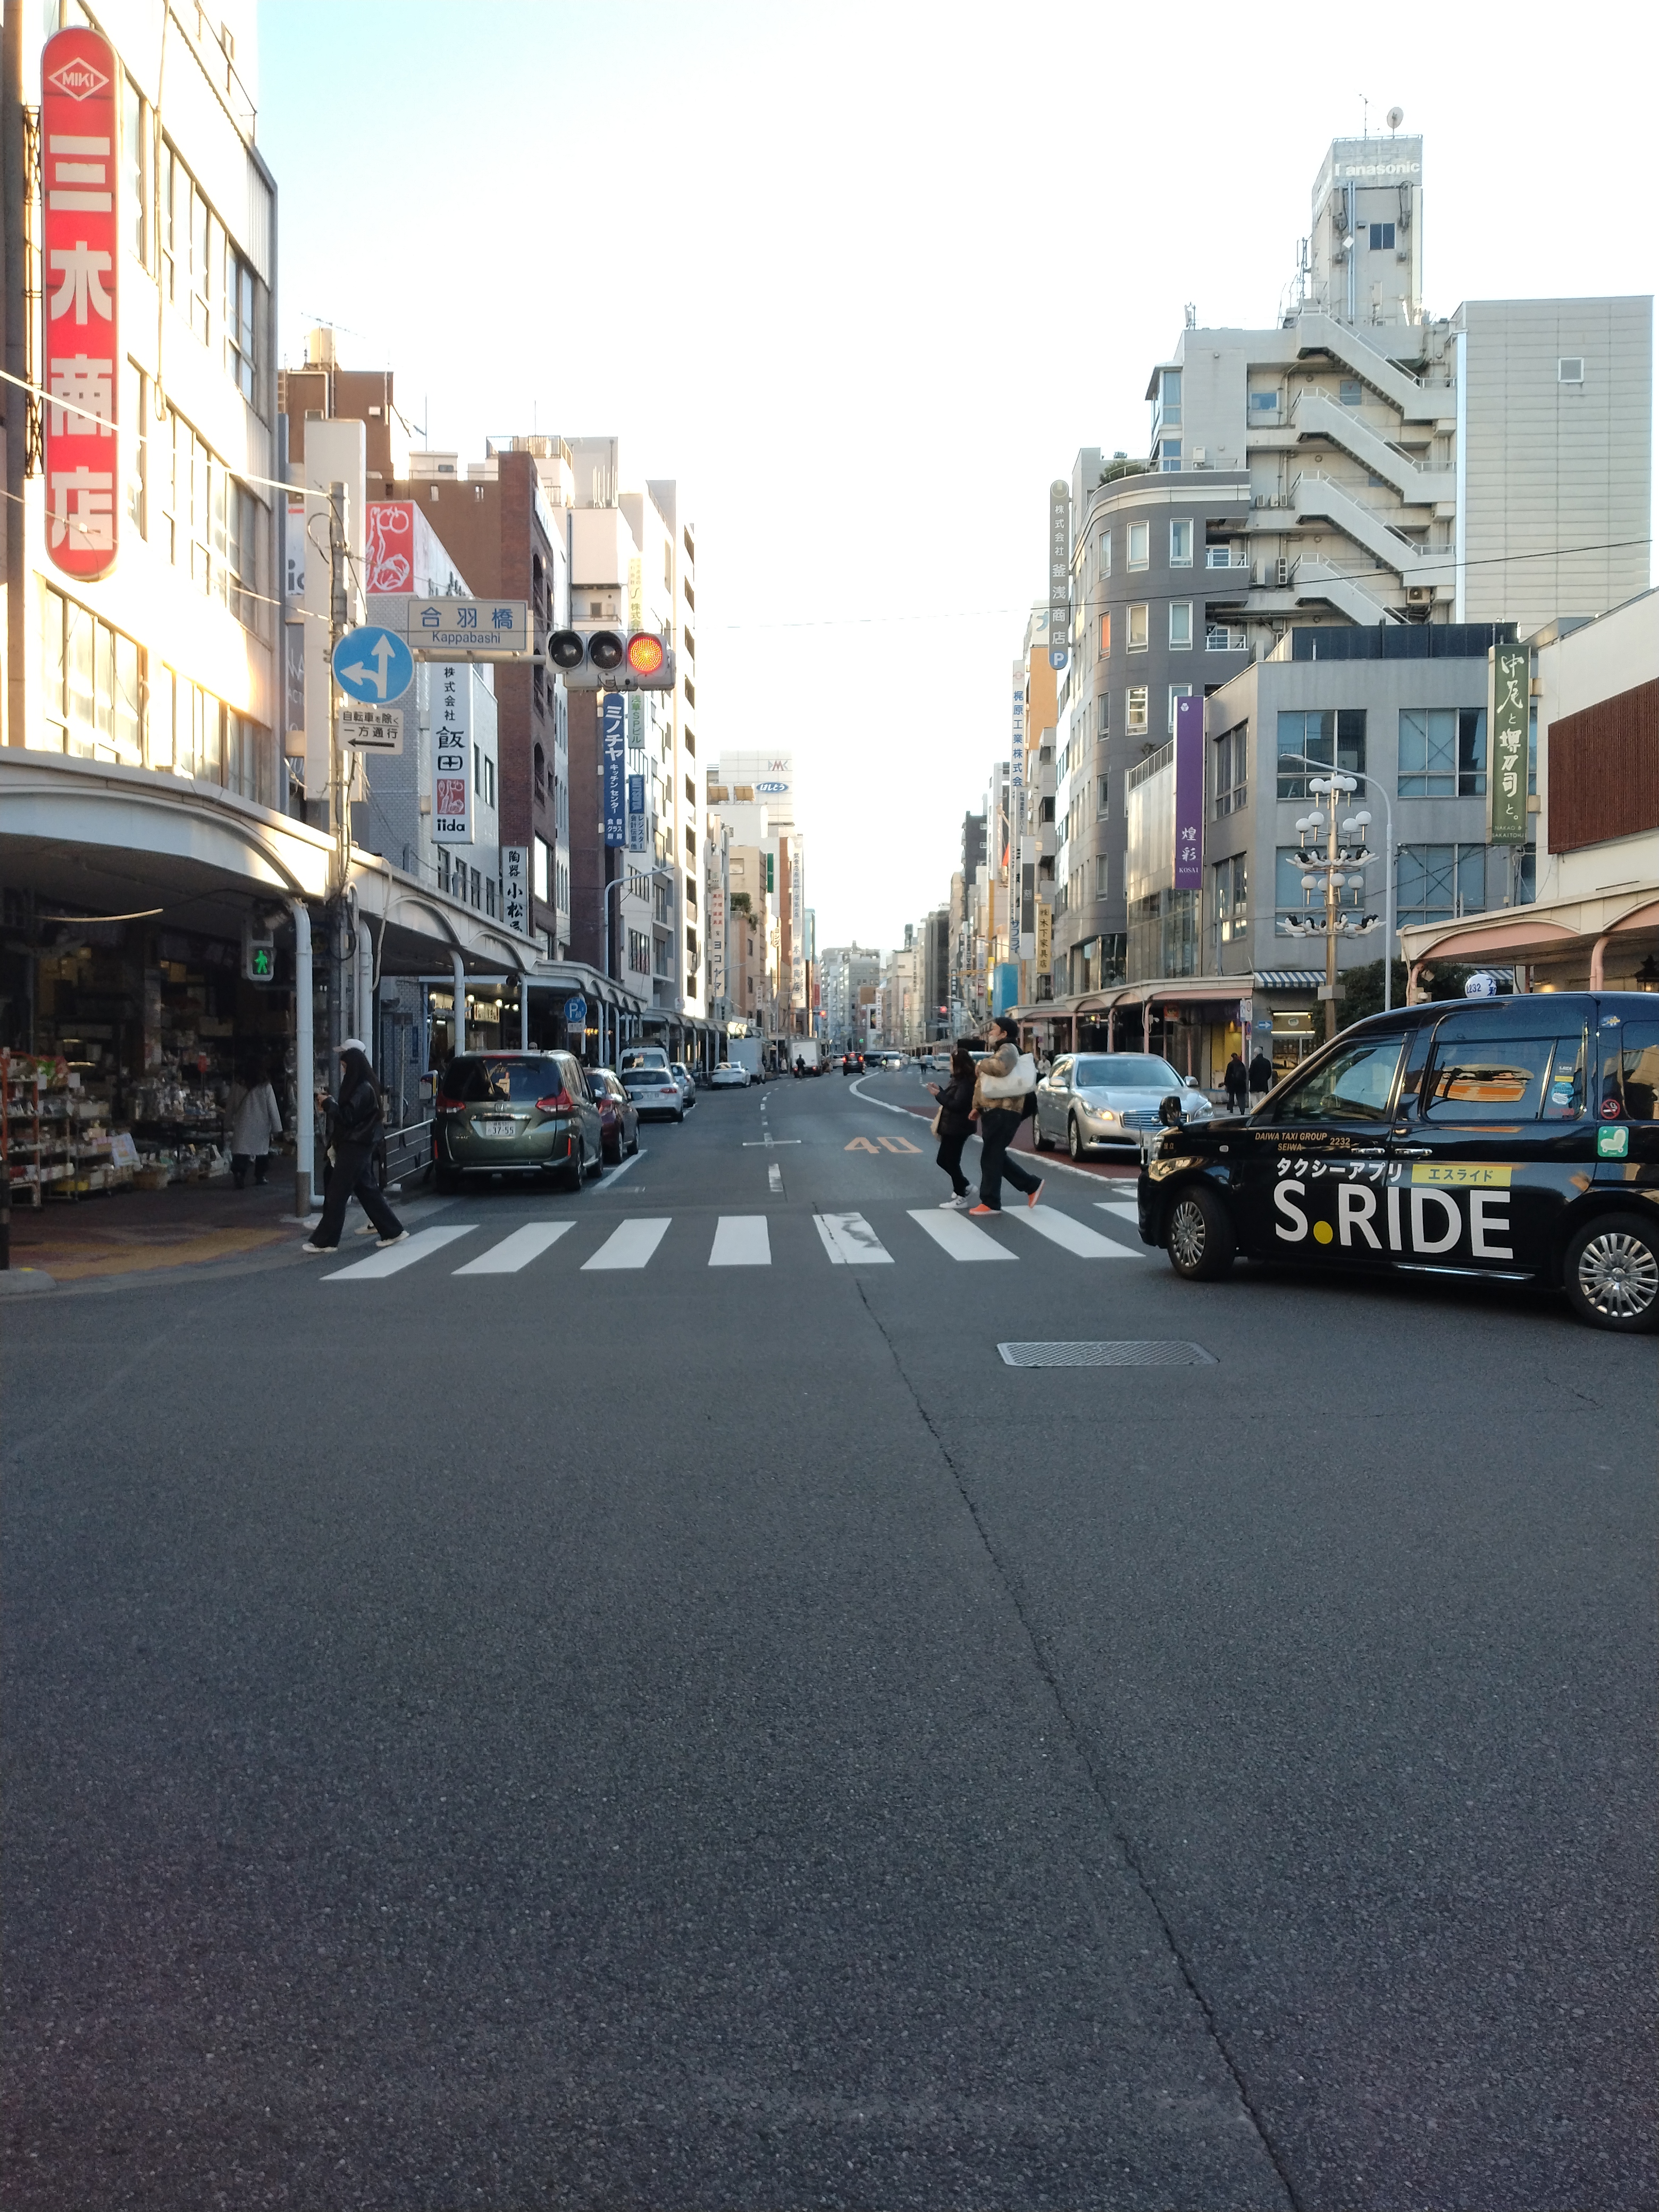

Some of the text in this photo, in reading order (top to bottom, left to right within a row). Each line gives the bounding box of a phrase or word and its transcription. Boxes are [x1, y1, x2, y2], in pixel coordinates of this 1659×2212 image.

[63, 71, 94, 87] MIKI
[49, 135, 112, 551] 三木商店
[420, 607, 513, 629] 合羽橋
[433, 631, 500, 644] Kappabashi
[1054, 652, 1064, 665] P
[343, 711, 399, 725] 自転車を除く
[343, 726, 398, 739] 一方通行
[437, 818, 465, 832] iida
[1182, 827, 1196, 861] 煌彩
[569, 1003, 578, 1018] P
[844, 1137, 923, 1153] 40
[1276, 1158, 1403, 1183] タクシーアプリ
[1428, 1168, 1494, 1182] エスライド
[1274, 1179, 1513, 1259] S.RIDE
